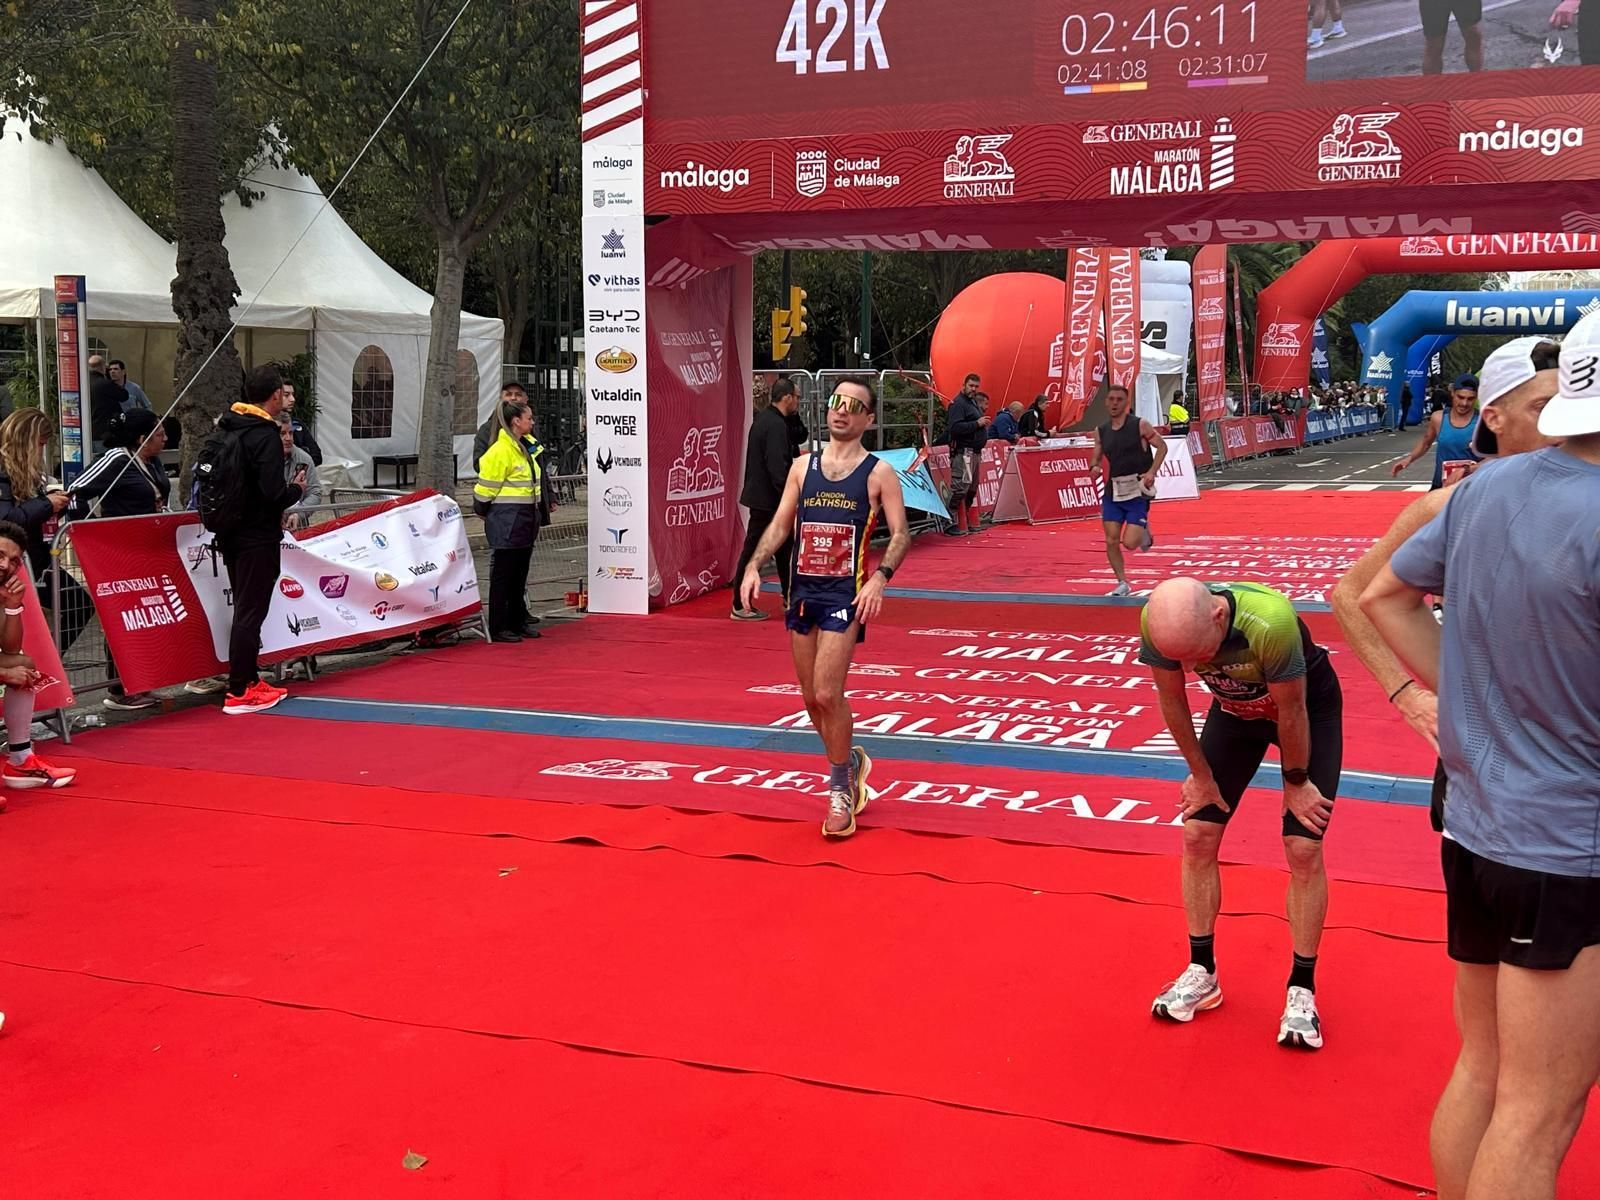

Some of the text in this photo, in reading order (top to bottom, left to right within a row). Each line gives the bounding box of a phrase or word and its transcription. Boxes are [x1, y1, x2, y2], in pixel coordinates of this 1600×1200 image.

[776, 0, 890, 74] 42K
[1061, 3, 1258, 56] 02:46:11
[1057, 59, 1148, 84] 02:41:08
[1178, 53, 1268, 77] 02:31:07
[1110, 120, 1203, 142] GENERALI
[1154, 147, 1200, 164] MARATÓN
[833, 157, 880, 172] Ciudad
[1317, 163, 1401, 181] GENERALI
[833, 173, 900, 188] de Málaga
[1110, 161, 1203, 195] MÁLAGA
[943, 181, 1015, 199] GENERALI
[1446, 232, 1600, 257] GENERALI
[600, 250, 626, 259] luanvi
[603, 274, 640, 286] vithas
[588, 309, 640, 322] BYD
[1446, 298, 1566, 327] luanvi
[63, 331, 69, 342] 5
[589, 325, 640, 333] Caetano Tec
[1260, 347, 1300, 357] GENERALI
[680, 360, 719, 386] MÁLAGA
[591, 388, 642, 401] Vitaldin
[595, 415, 637, 426] POWER
[613, 425, 637, 436] ADE
[1051, 457, 1089, 473] GENERALI
[603, 497, 633, 508] Natura
[816, 490, 846, 499] LONDON
[1057, 484, 1099, 509] MÁLAGA
[665, 496, 725, 528] GENERALI
[803, 497, 858, 511] HEATHSIDE
[811, 525, 846, 535] GENERALI
[812, 536, 833, 548] 395
[112, 576, 159, 595] GENERALI
[121, 604, 176, 632] MÁLAGA
[843, 688, 1153, 717] GENERALI
[957, 709, 1124, 729] MARATÓN
